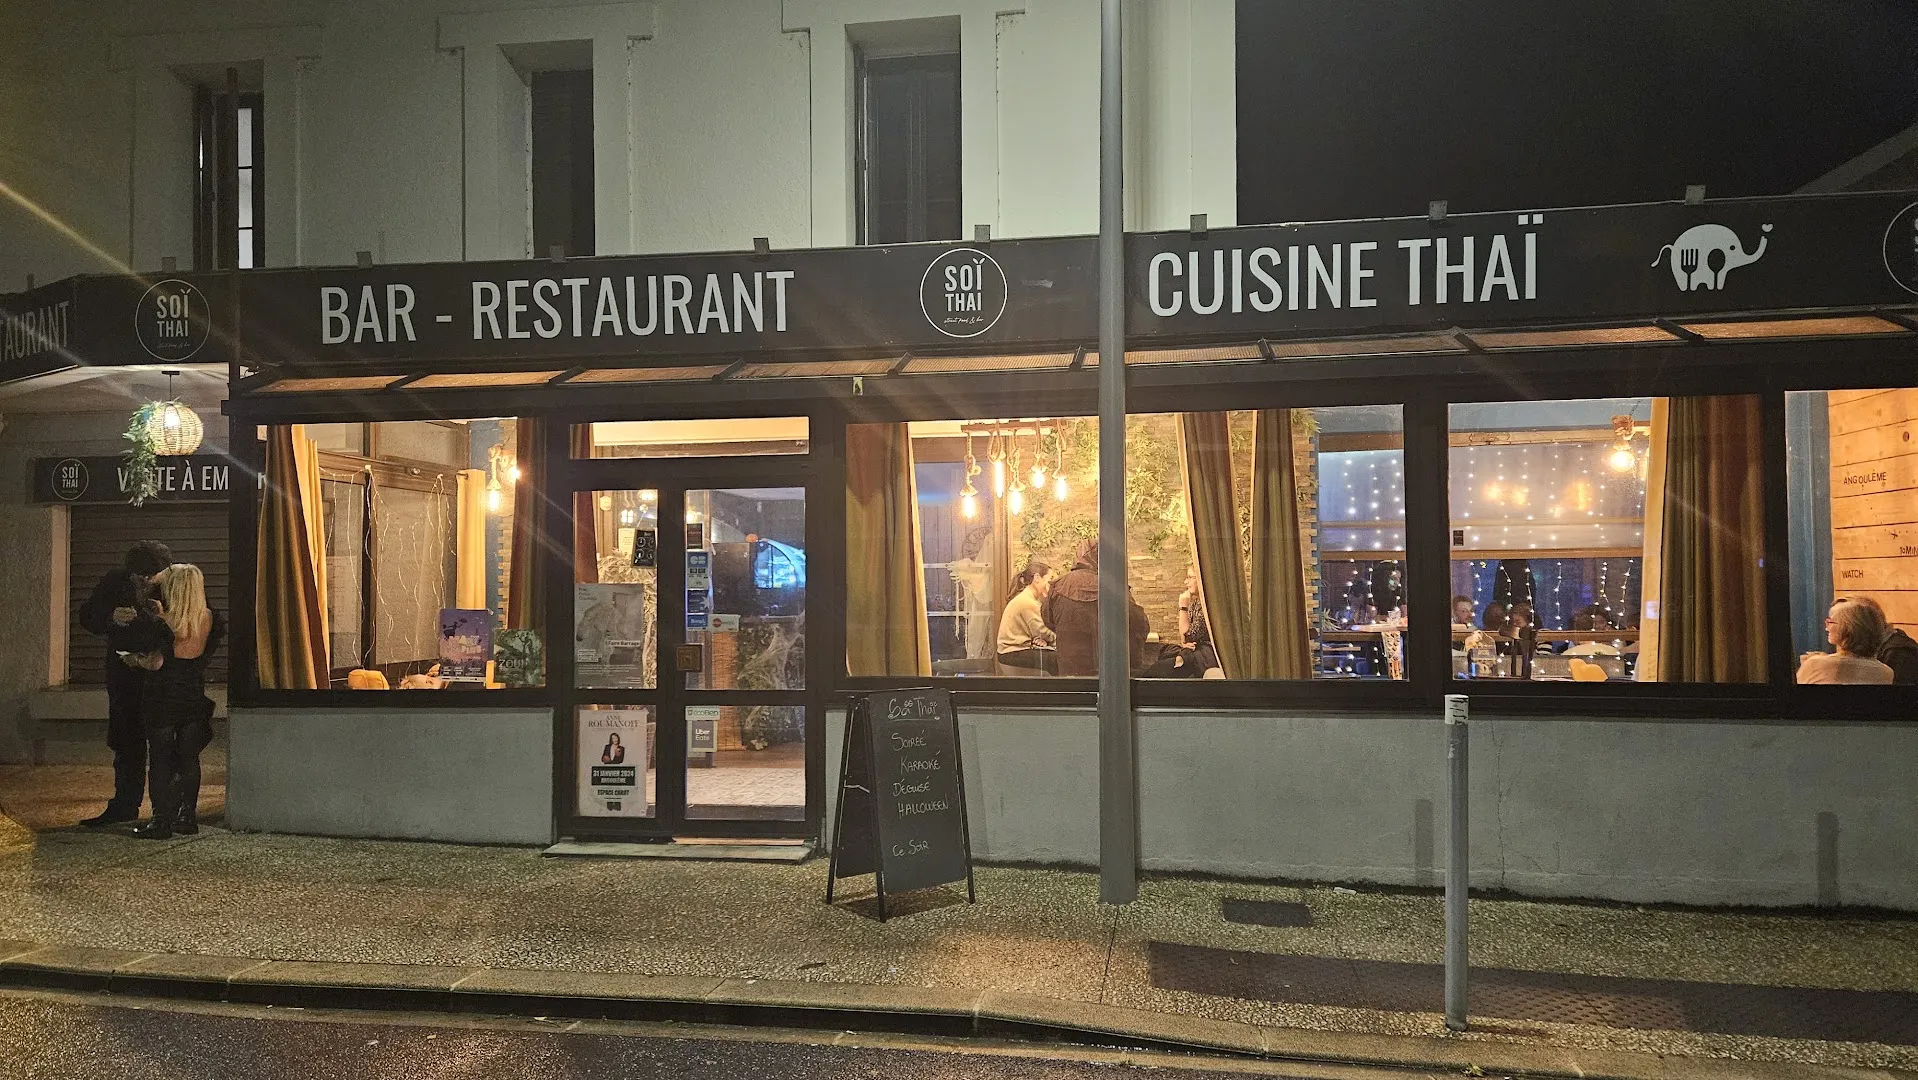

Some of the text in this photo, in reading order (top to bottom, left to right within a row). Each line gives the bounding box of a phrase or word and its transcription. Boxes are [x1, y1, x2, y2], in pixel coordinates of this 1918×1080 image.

[1148, 213, 1544, 317] CUISINE THAÏ
[320, 270, 795, 345] BAR - RESTAURANT
[944, 292, 982, 312] THAI
[156, 320, 189, 338] THAI
[62, 479, 79, 489] THAI
[117, 466, 176, 492] VTE
[181, 459, 195, 491] À
[1841, 569, 1864, 579] WATCH
